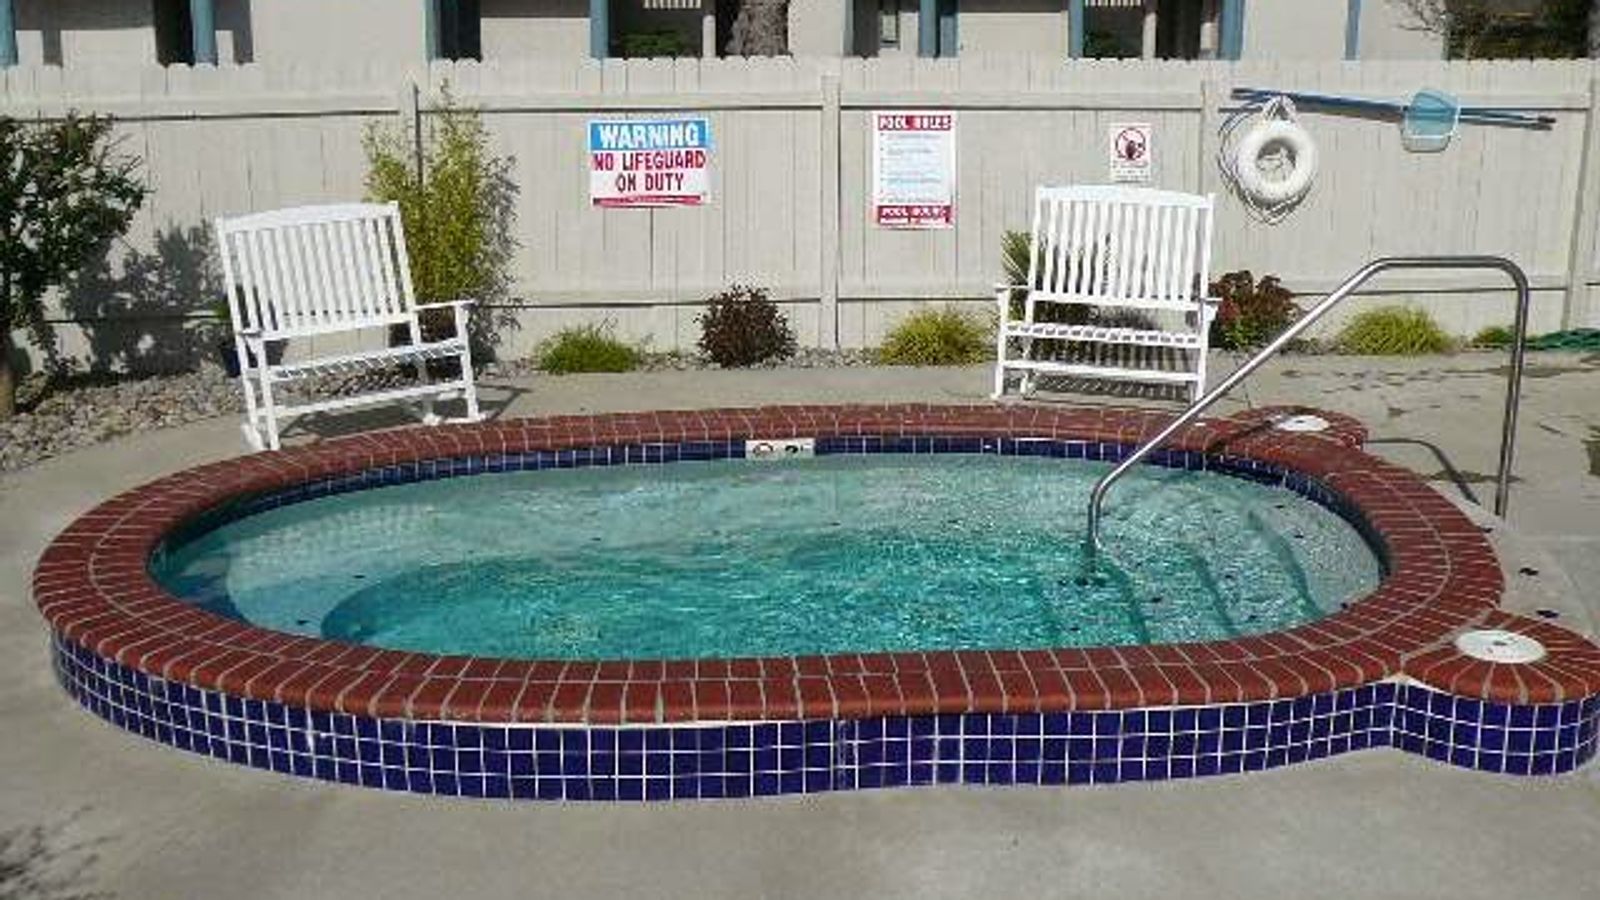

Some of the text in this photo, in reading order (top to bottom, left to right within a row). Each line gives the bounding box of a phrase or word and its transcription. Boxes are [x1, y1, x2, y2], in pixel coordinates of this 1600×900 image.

[598, 123, 700, 148] WARNING
[594, 150, 705, 171] NO LIFEGUARD
[615, 173, 683, 193] ON DUTY
